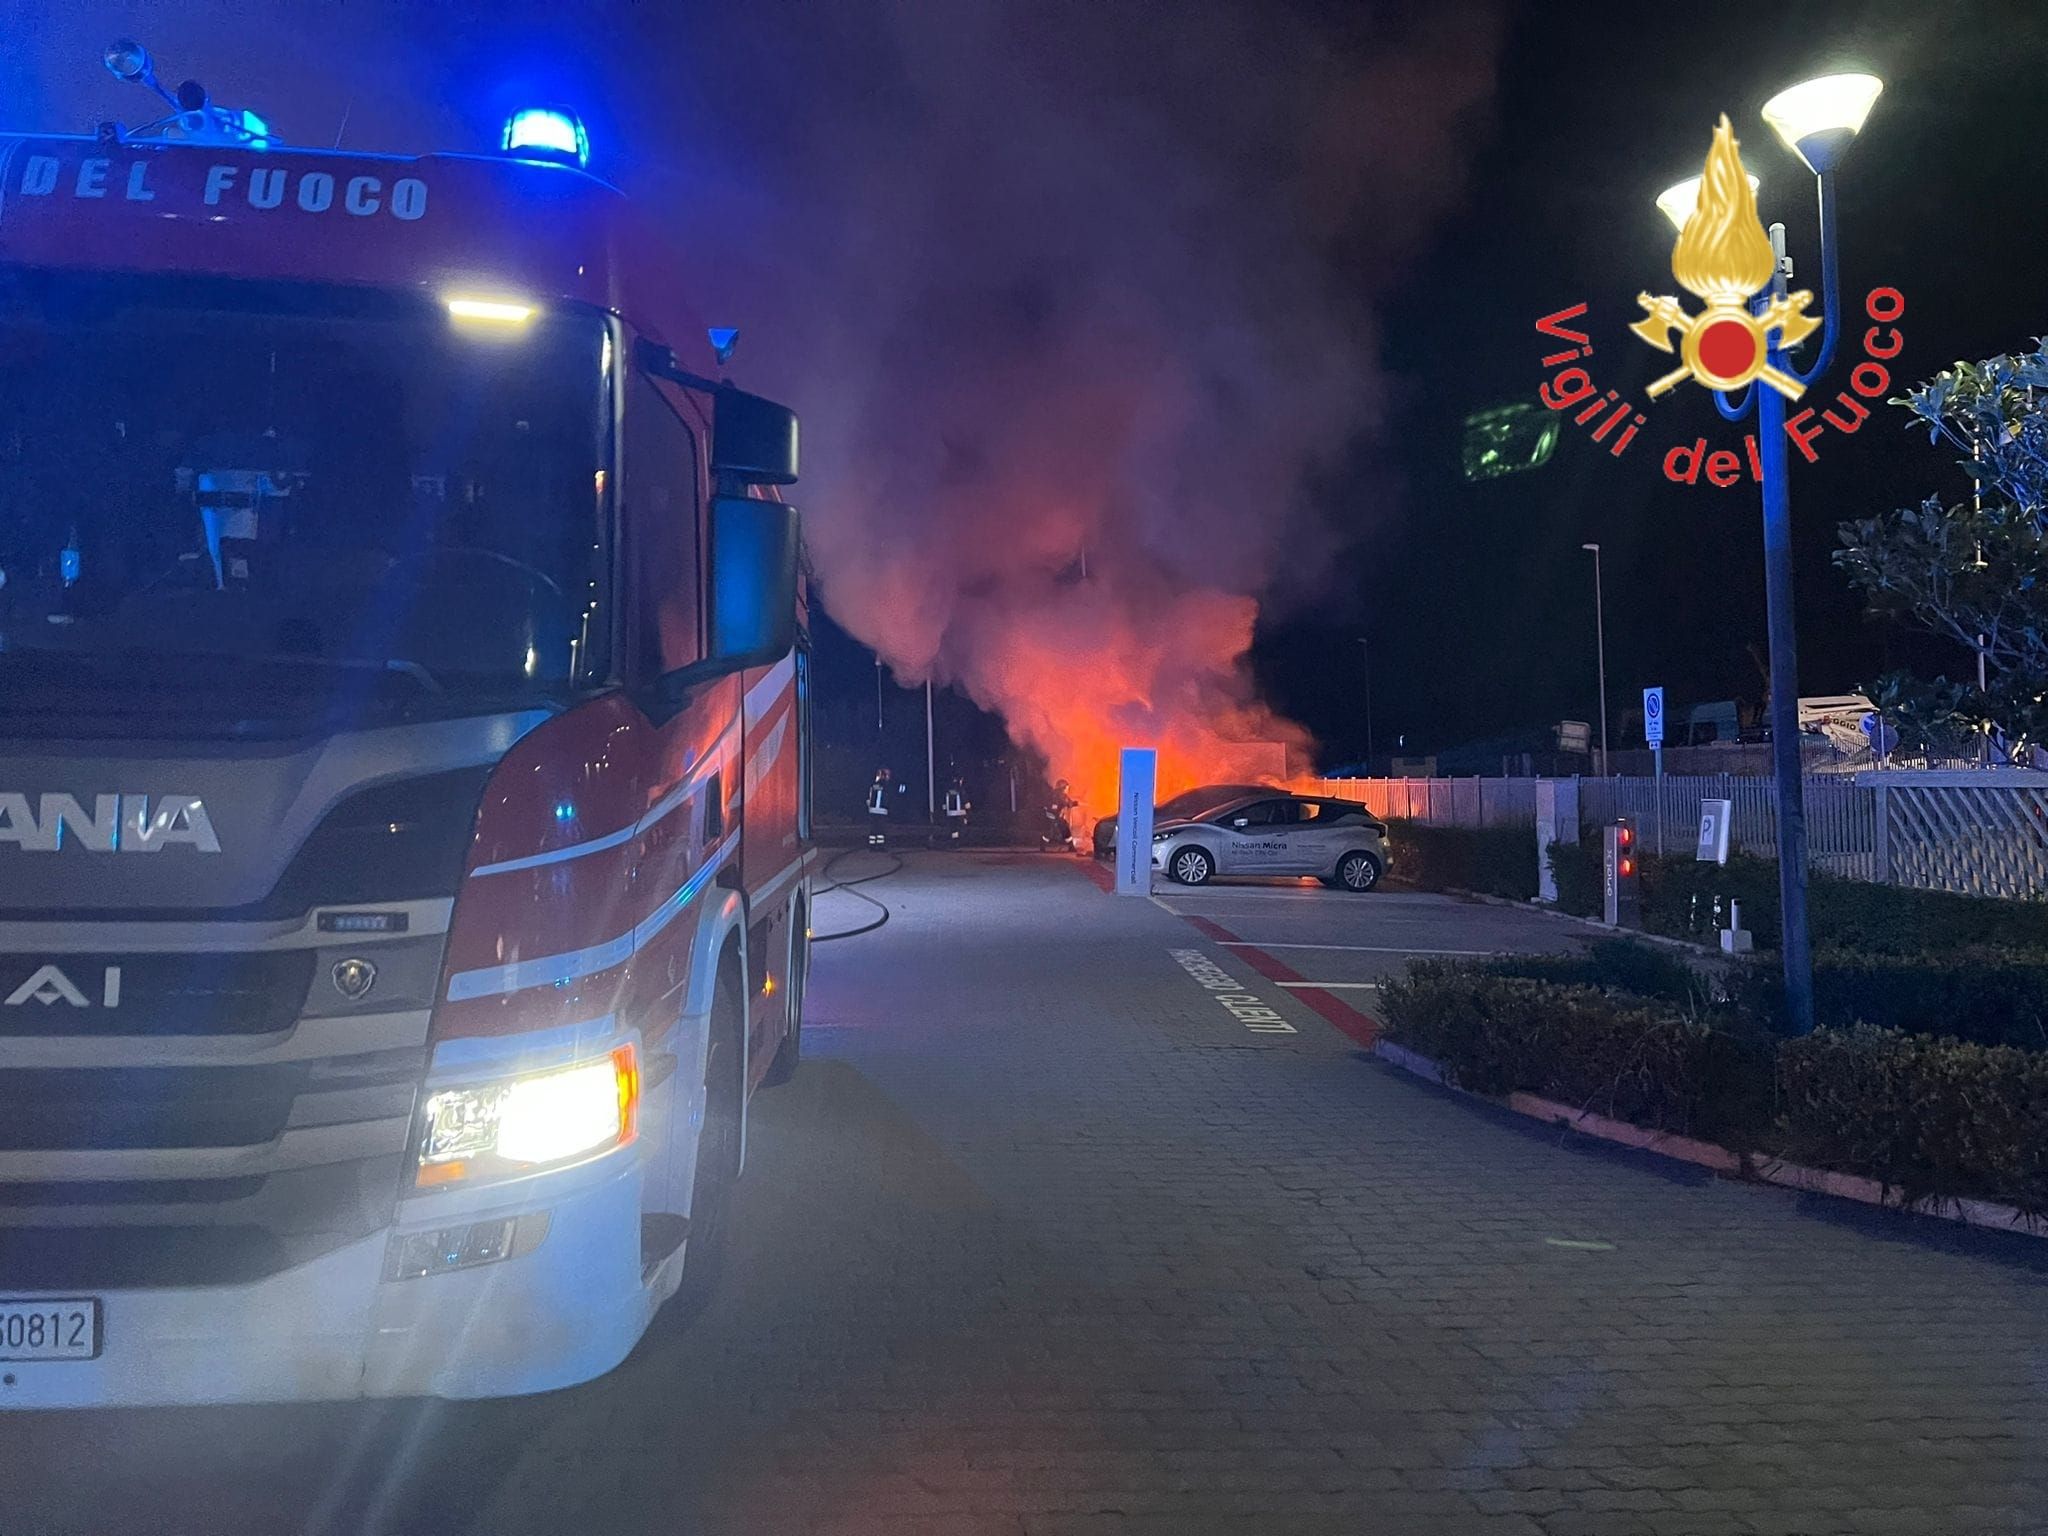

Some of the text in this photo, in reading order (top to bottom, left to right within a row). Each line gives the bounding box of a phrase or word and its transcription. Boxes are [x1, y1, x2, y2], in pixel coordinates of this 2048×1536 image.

[20, 155, 428, 220] DEL FUOCO
[1232, 841, 1287, 849] Nissan Micra
[1215, 994, 1298, 1033] CLIENTI
[0, 1312, 85, 1348] 0812
